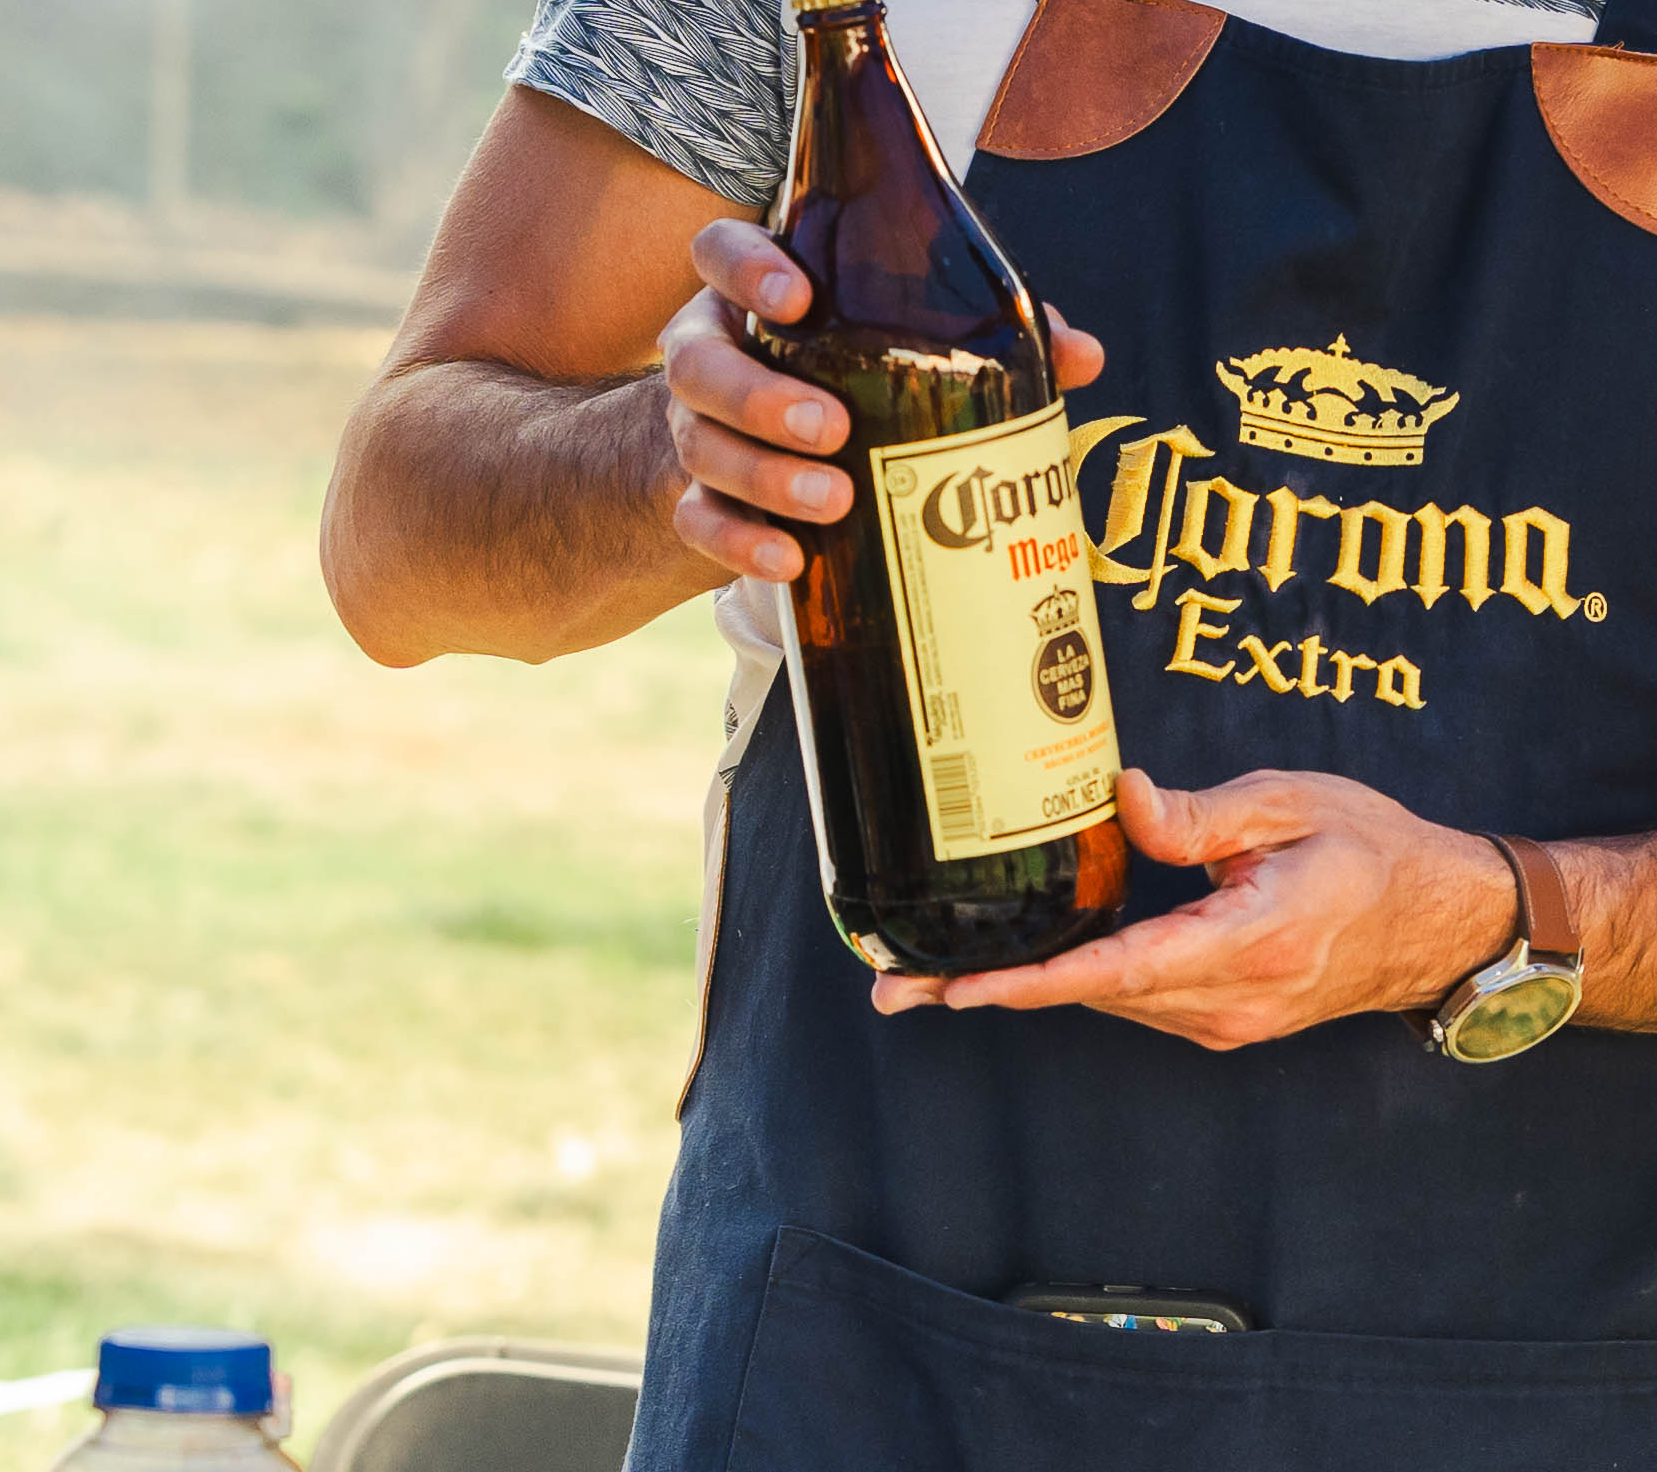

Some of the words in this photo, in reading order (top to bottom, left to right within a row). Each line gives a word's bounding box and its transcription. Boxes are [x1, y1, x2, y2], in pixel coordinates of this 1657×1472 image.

[1069, 415, 1582, 619] Corona
[1056, 644, 1077, 663] LA
[1165, 588, 1427, 710] Extra
